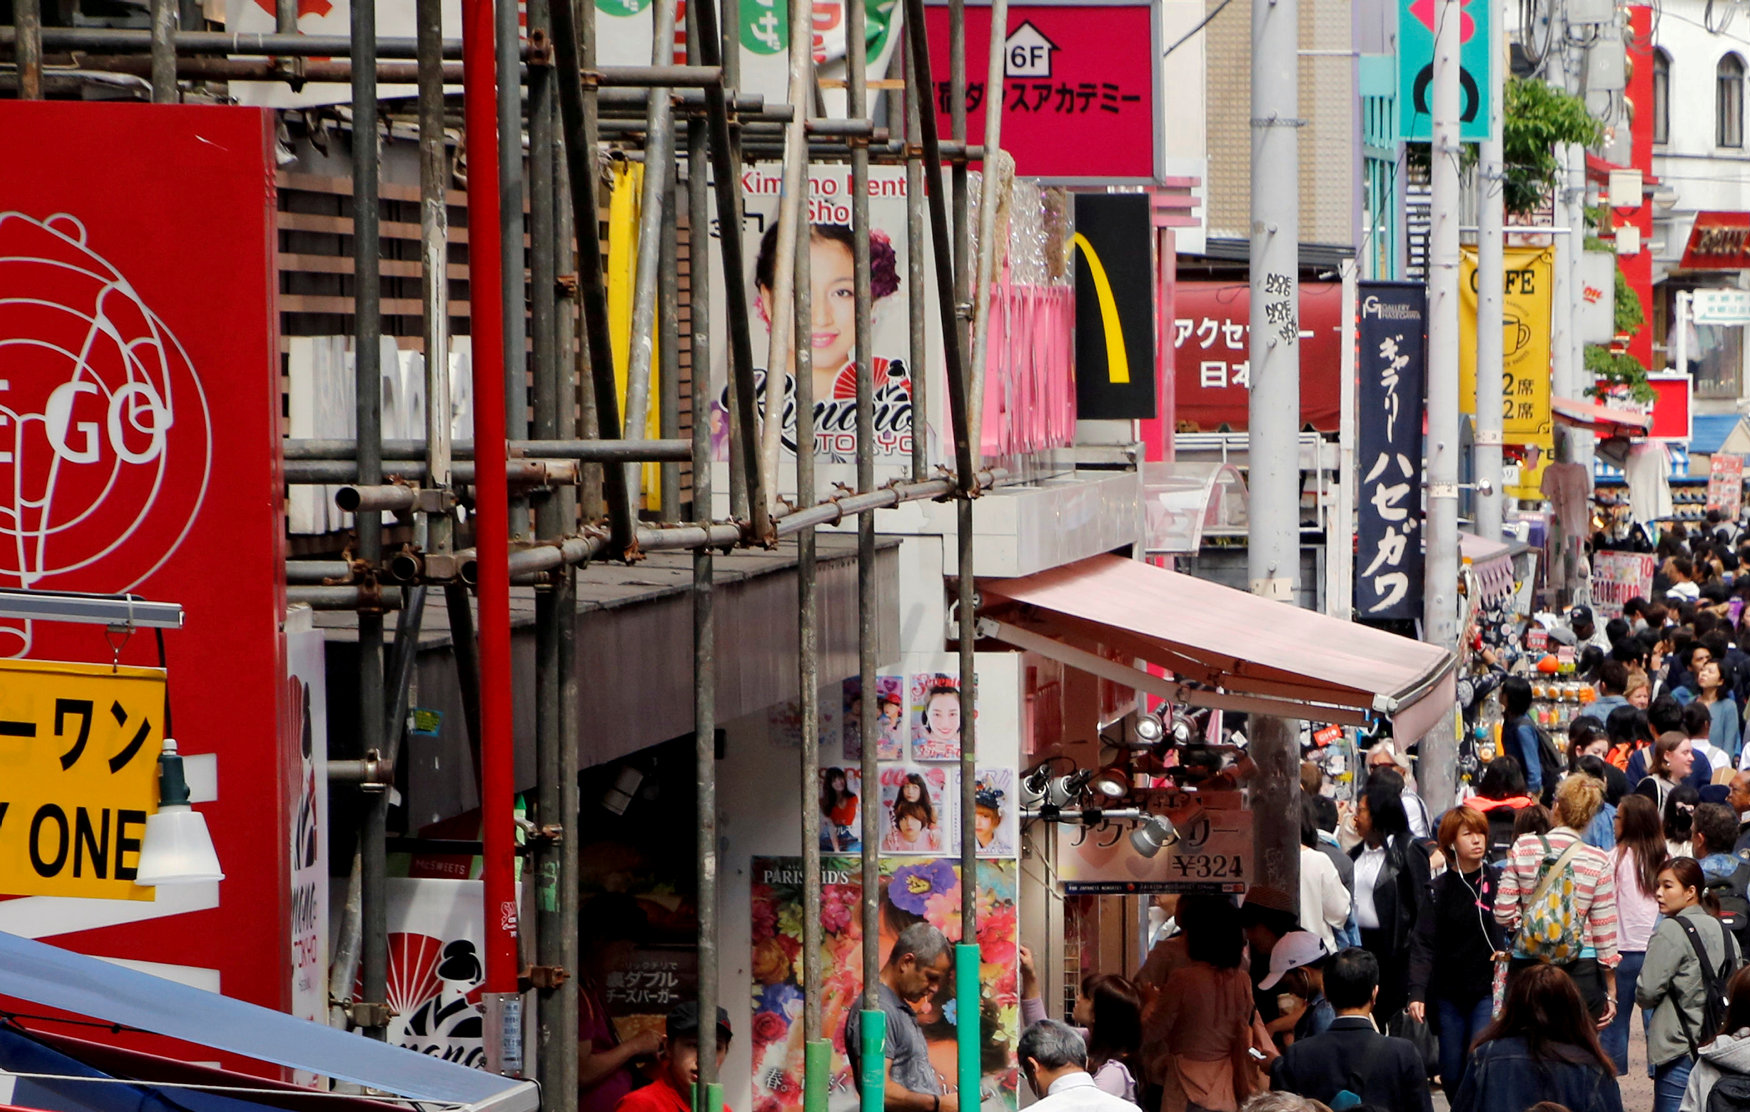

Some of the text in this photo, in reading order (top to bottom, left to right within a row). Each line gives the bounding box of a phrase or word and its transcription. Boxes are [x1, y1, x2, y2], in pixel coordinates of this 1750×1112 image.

[1011, 46, 1044, 68] 6F
[741, 171, 838, 196] Kimno
[1380, 334, 1410, 443] ギャラリー
[0, 380, 164, 464] GO
[815, 433, 913, 452] TOYO
[1361, 452, 1418, 613] ハセガワ
[29, 803, 146, 881] ONE
[820, 869, 850, 884] ID'S
[1171, 855, 1243, 878] ¥324
